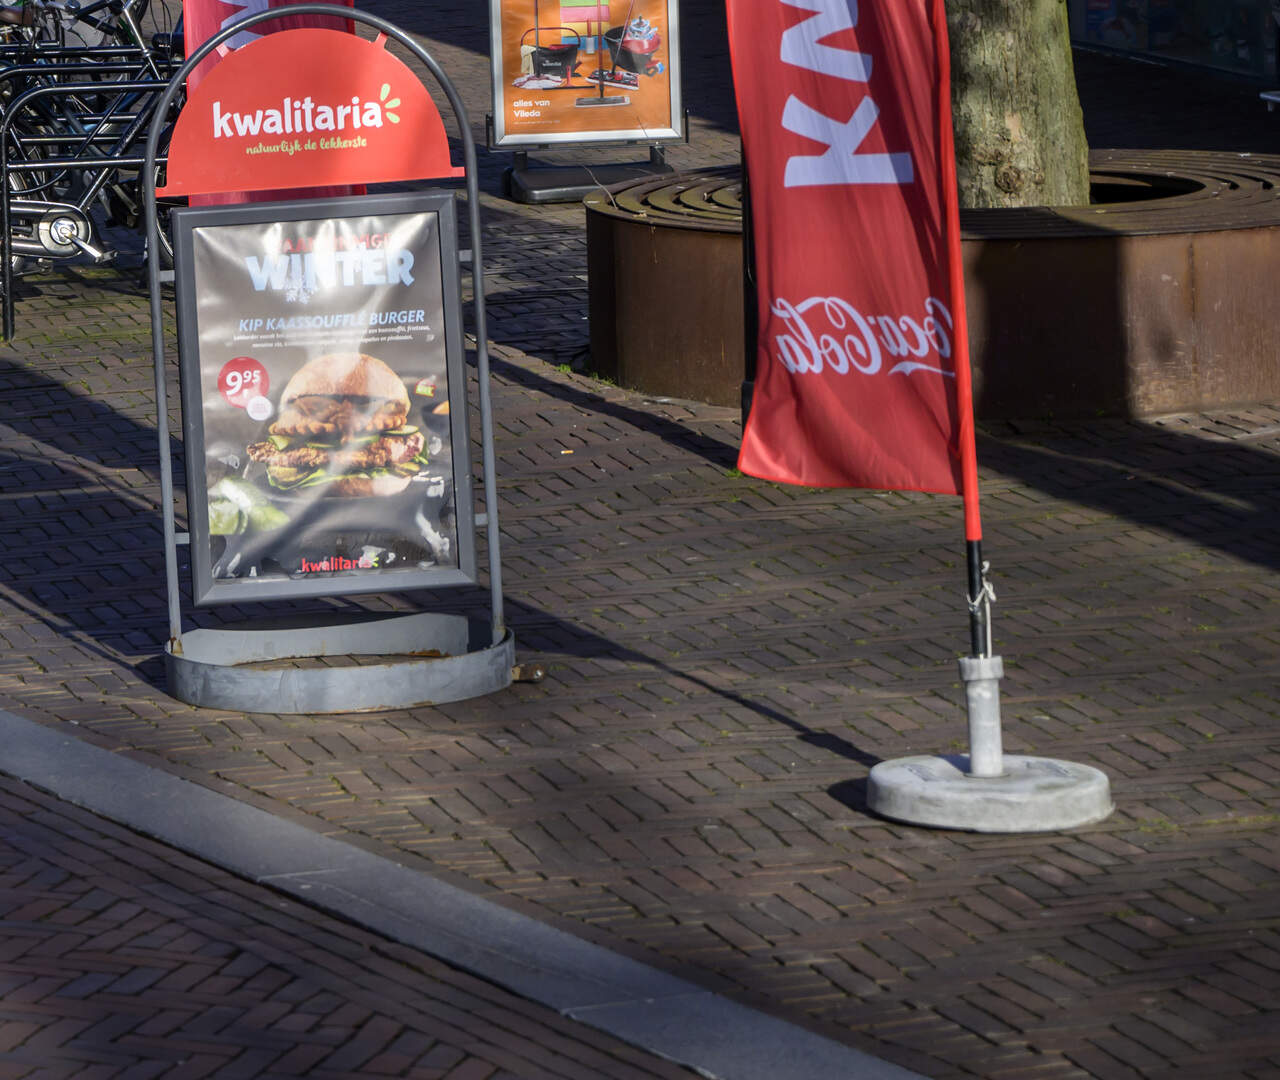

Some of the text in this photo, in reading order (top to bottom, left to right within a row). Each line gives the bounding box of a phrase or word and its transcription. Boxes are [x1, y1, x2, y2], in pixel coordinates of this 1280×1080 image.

[513, 99, 551, 108] alles van
[513, 109, 541, 118] Vileda
[212, 96, 384, 139] kwalitaria
[245, 136, 368, 156] natuurlijk de lekkerste
[245, 245, 415, 292] WINTER
[239, 317, 264, 332] KIP
[368, 309, 425, 326] BURGER
